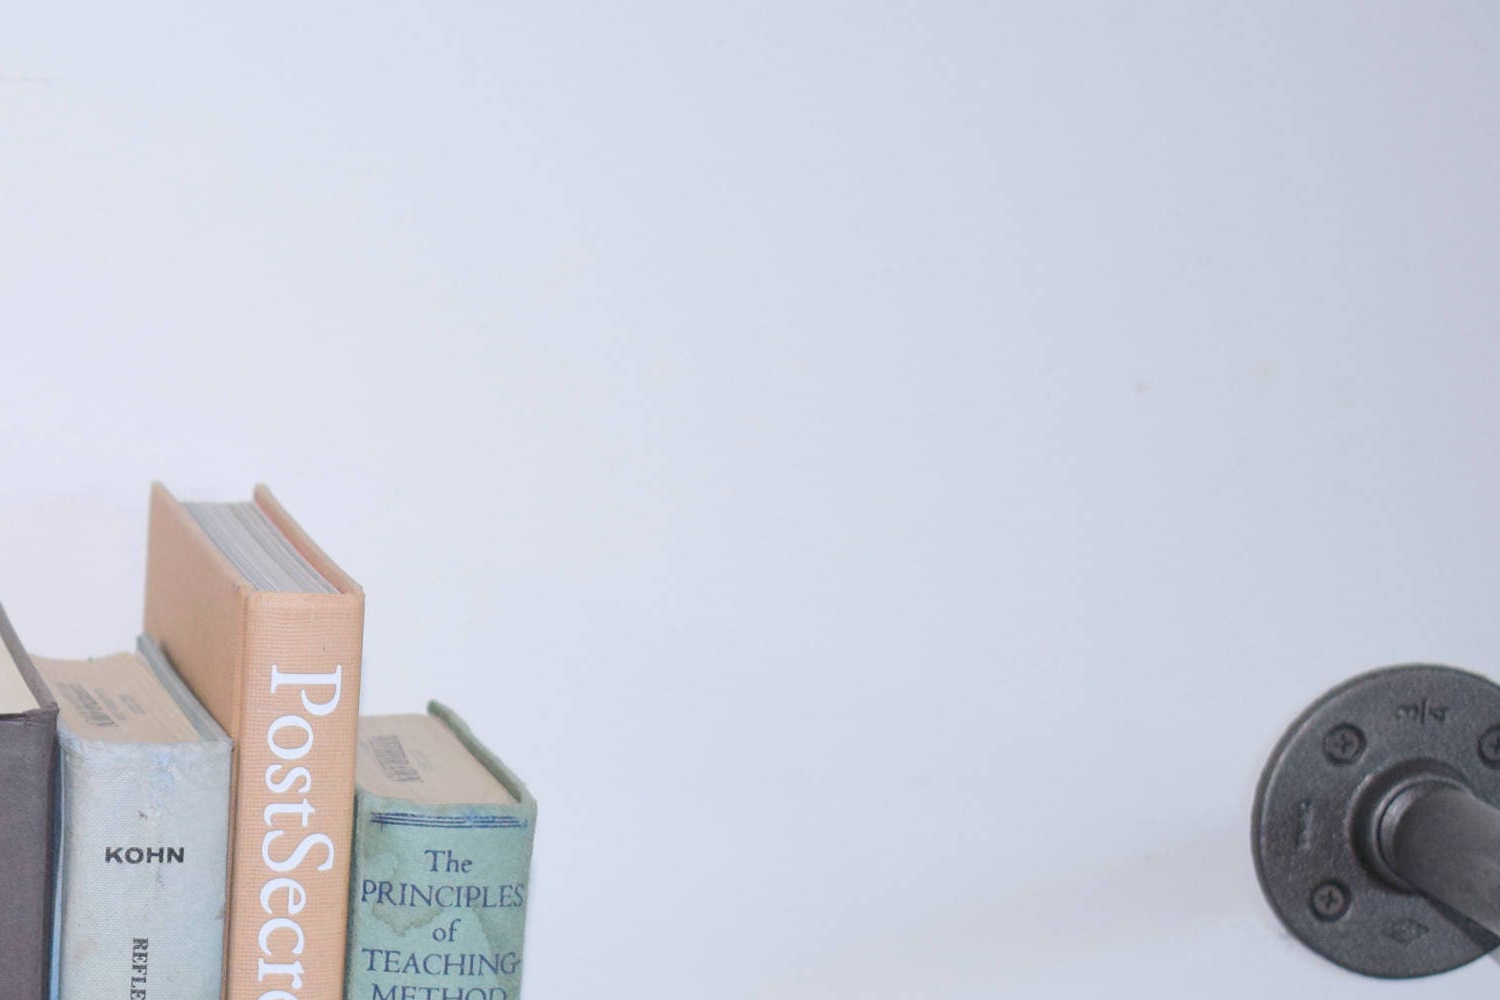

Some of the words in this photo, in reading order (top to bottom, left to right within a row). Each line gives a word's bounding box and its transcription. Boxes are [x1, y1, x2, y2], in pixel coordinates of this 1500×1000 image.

[105, 846, 185, 864] KOHN
[424, 849, 473, 874] The
[361, 878, 525, 909] PRINCIPLES
[431, 918, 462, 943] of
[361, 948, 522, 977] TEACHING
